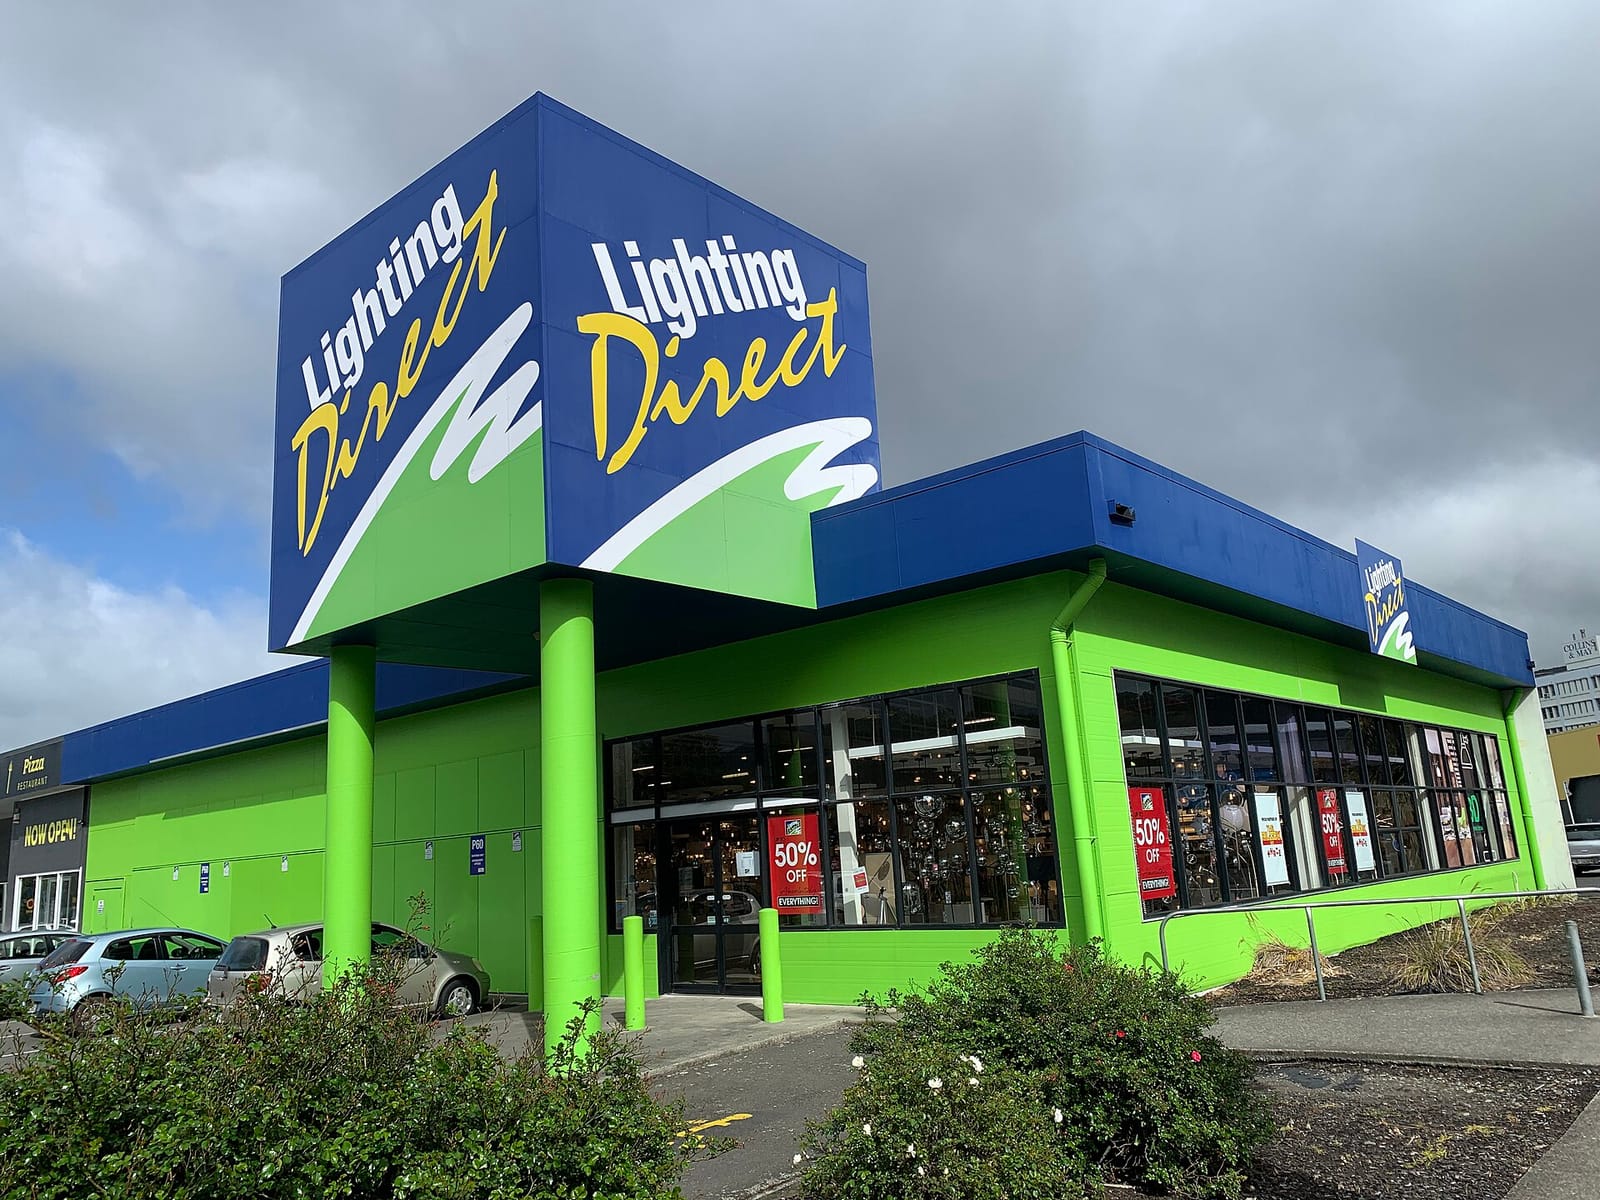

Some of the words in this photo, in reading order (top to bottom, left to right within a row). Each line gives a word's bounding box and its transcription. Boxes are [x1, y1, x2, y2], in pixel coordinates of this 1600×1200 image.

[302, 183, 465, 411] Lighting
[591, 235, 808, 339] Lighting
[292, 168, 508, 558] Direct
[576, 286, 847, 475] Direct
[1364, 559, 1398, 599] Lighting
[1364, 571, 1405, 647] Direct
[1563, 639, 1595, 653] COLLINS
[1576, 648, 1593, 657] MAY
[22, 755, 46, 775] Pizza
[16, 775, 48, 791] RESTAURANT
[24, 823, 47, 847] NOW
[47, 818, 78, 844] OPEN!
[1135, 818, 1165, 847] 50%
[1322, 813, 1341, 834] 50%
[471, 839, 484, 850] P60
[774, 841, 818, 868] 50%
[1145, 848, 1160, 864] OFF
[786, 869, 807, 883] OFF
[778, 896, 819, 906] EVERYTHING!
